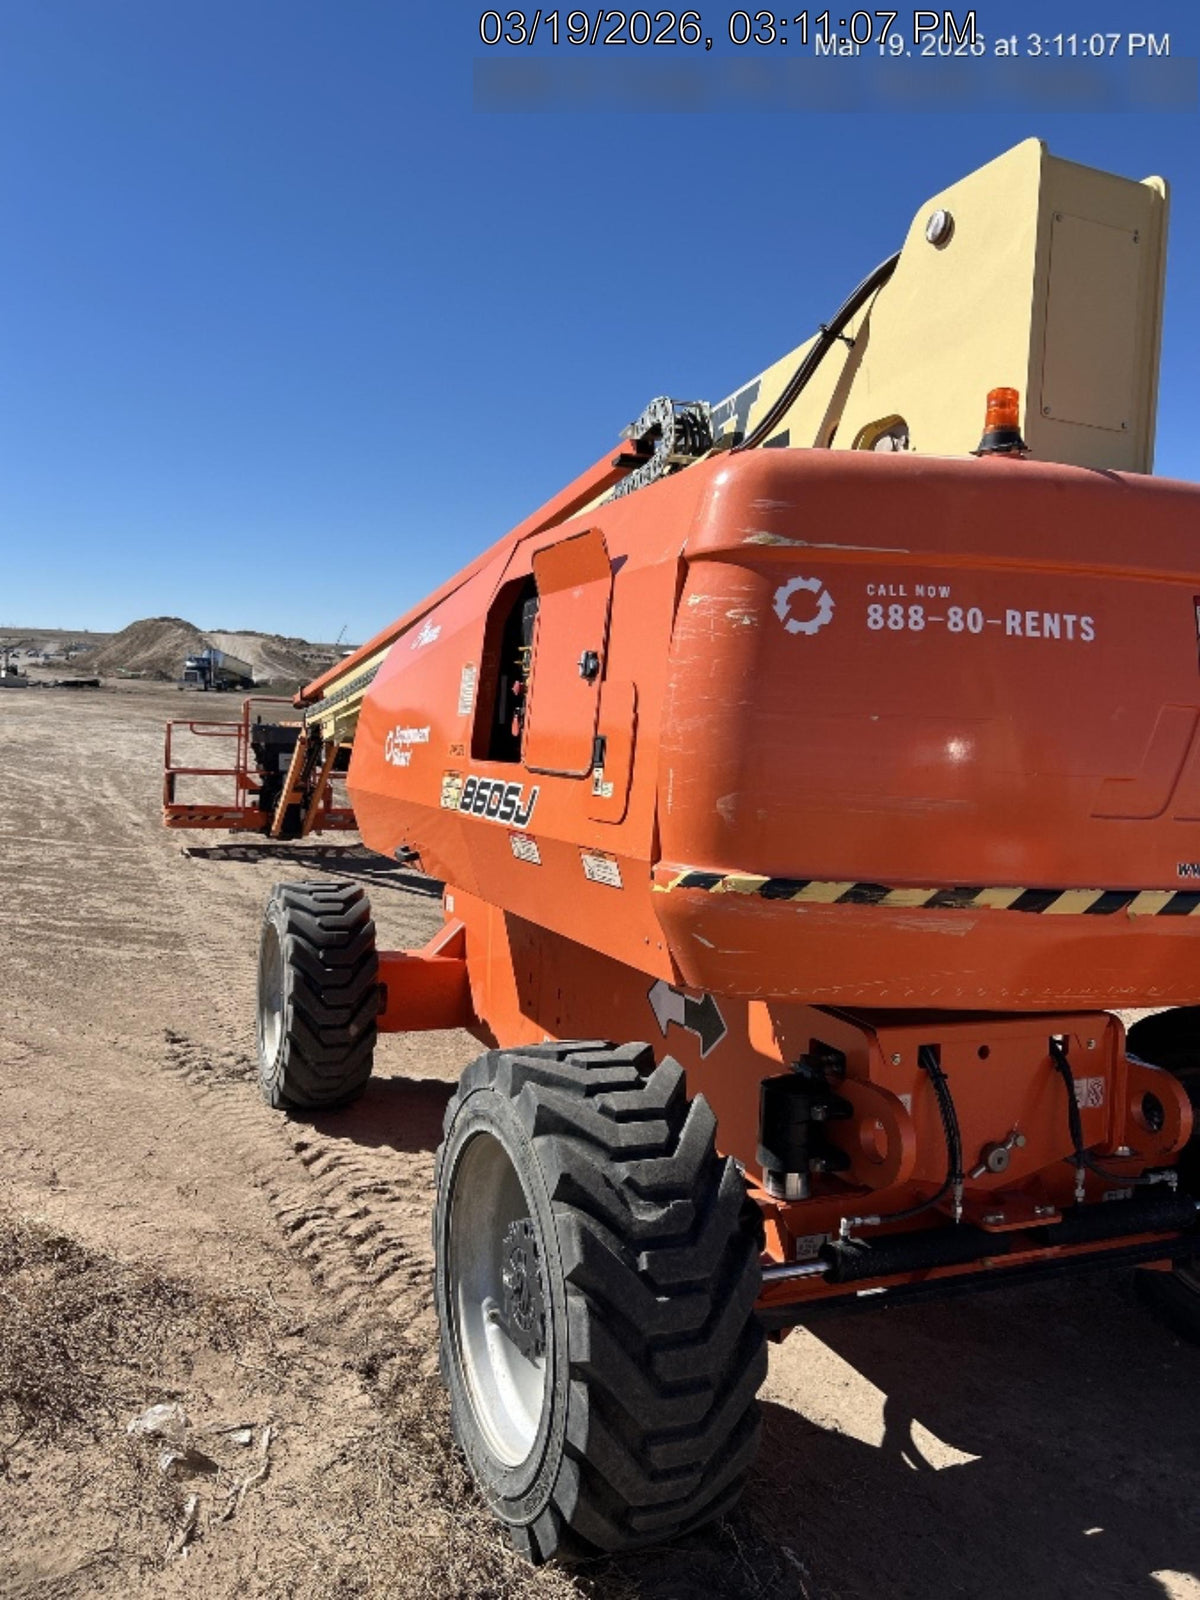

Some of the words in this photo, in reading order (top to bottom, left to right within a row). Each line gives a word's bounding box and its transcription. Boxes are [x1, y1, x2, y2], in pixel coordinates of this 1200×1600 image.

[866, 584, 908, 597] CALL
[915, 584, 951, 598] NOW
[866, 603, 1096, 642] 888-80-RENTS
[459, 775, 540, 828] 860SJ
